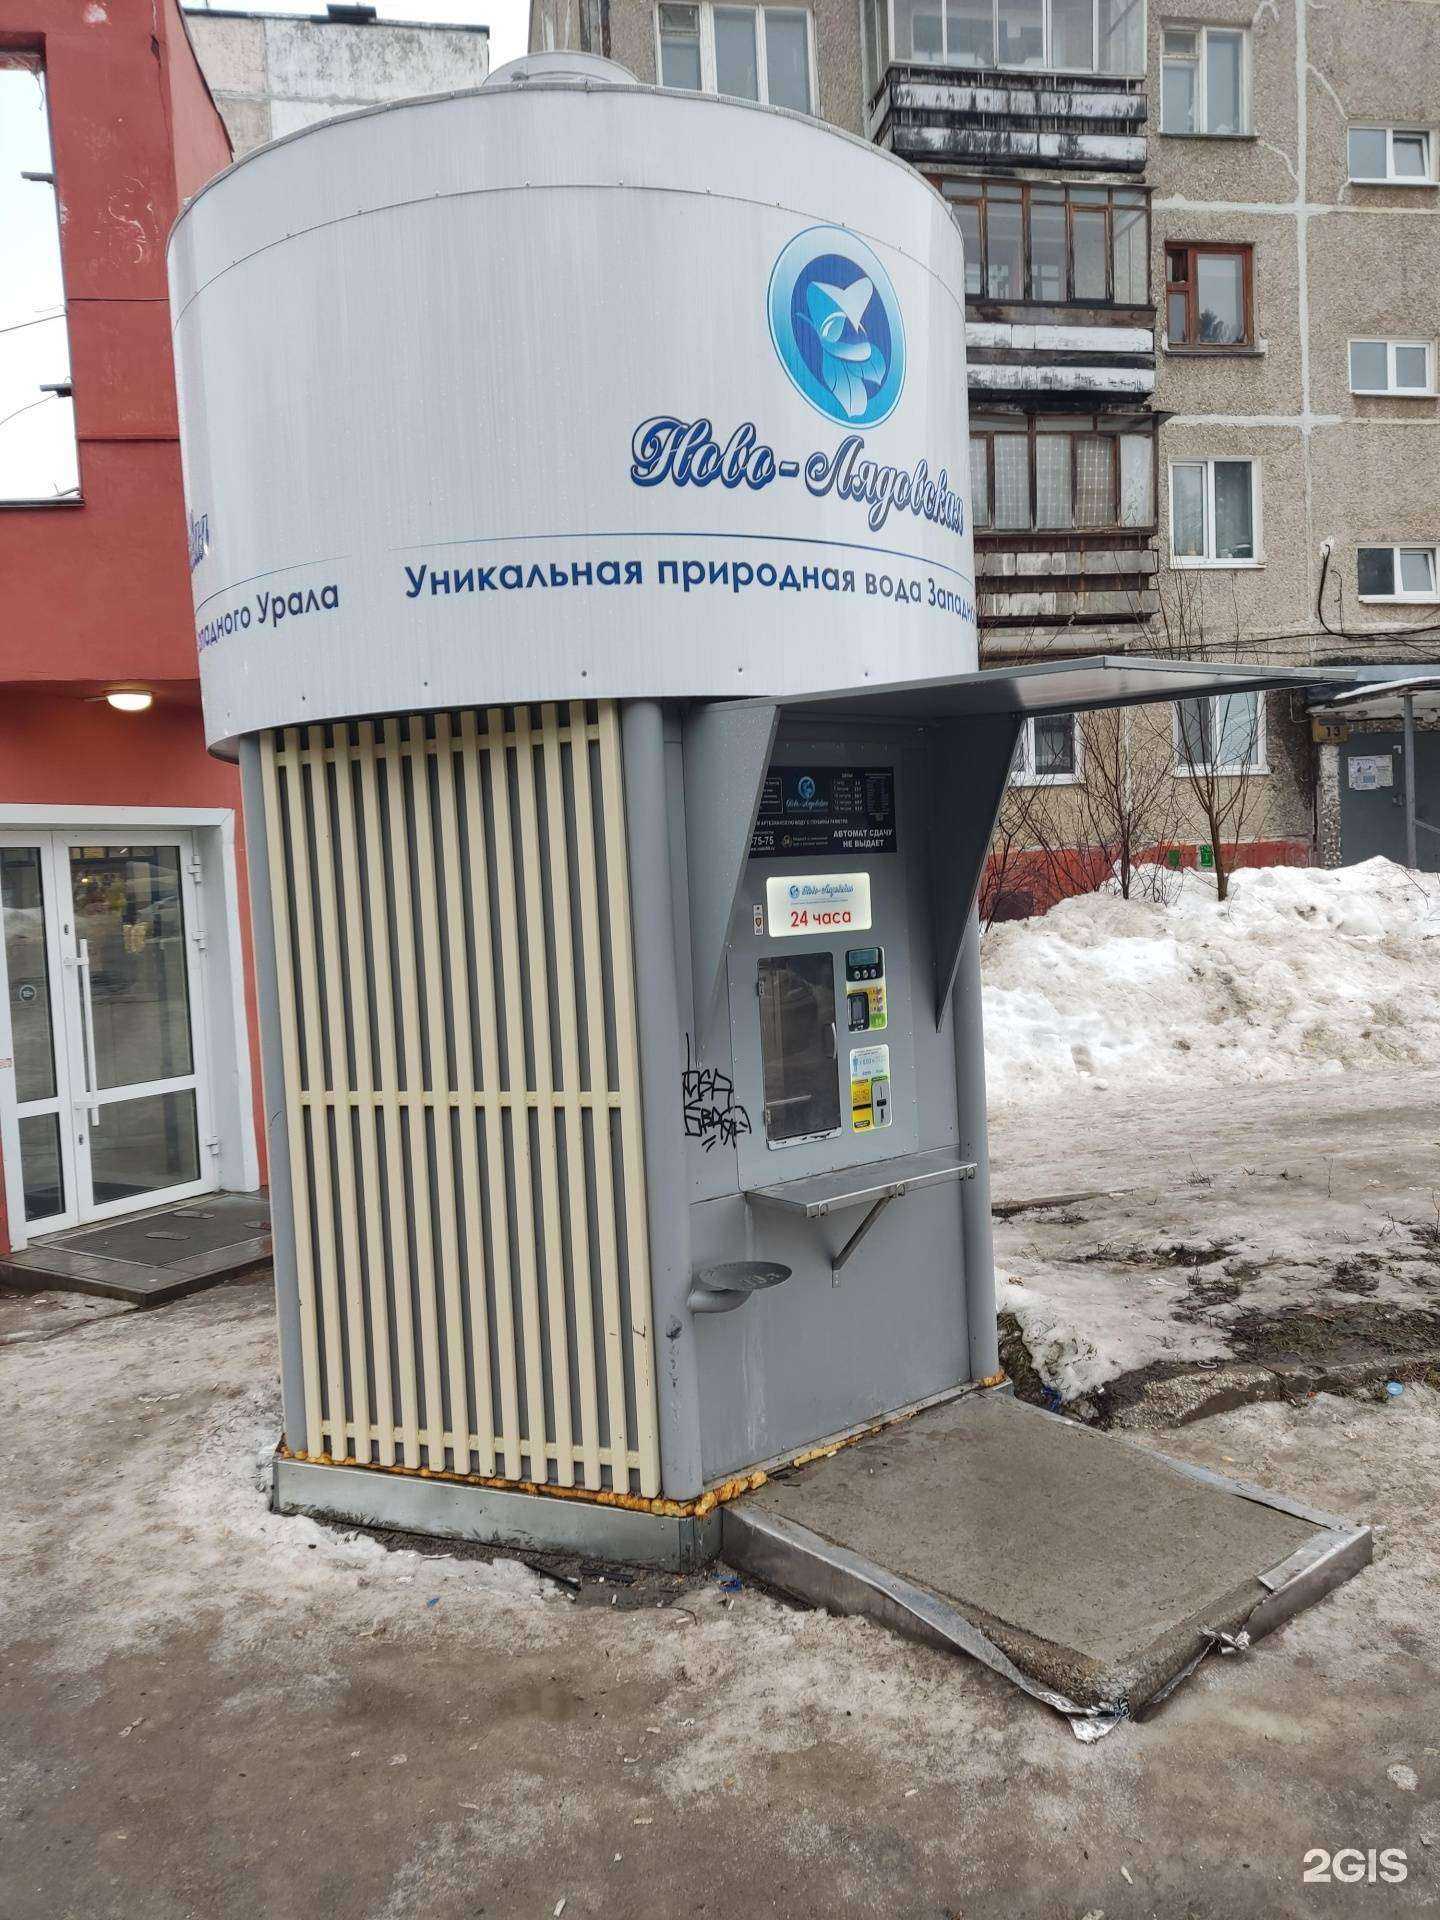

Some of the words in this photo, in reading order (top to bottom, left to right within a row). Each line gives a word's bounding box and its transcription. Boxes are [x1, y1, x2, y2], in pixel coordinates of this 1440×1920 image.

[404, 560, 643, 598] Уникальная
[657, 559, 856, 593] природная
[865, 573, 922, 603] вода
[256, 584, 340, 628] Урала
[833, 829, 868, 838] АВТОМАТ
[869, 828, 893, 838] СДАЧУ
[842, 840, 853, 848] НЕ
[854, 839, 884, 848] ВЫДАЕТ
[790, 910, 808, 928] 24
[813, 911, 852, 926] часа
